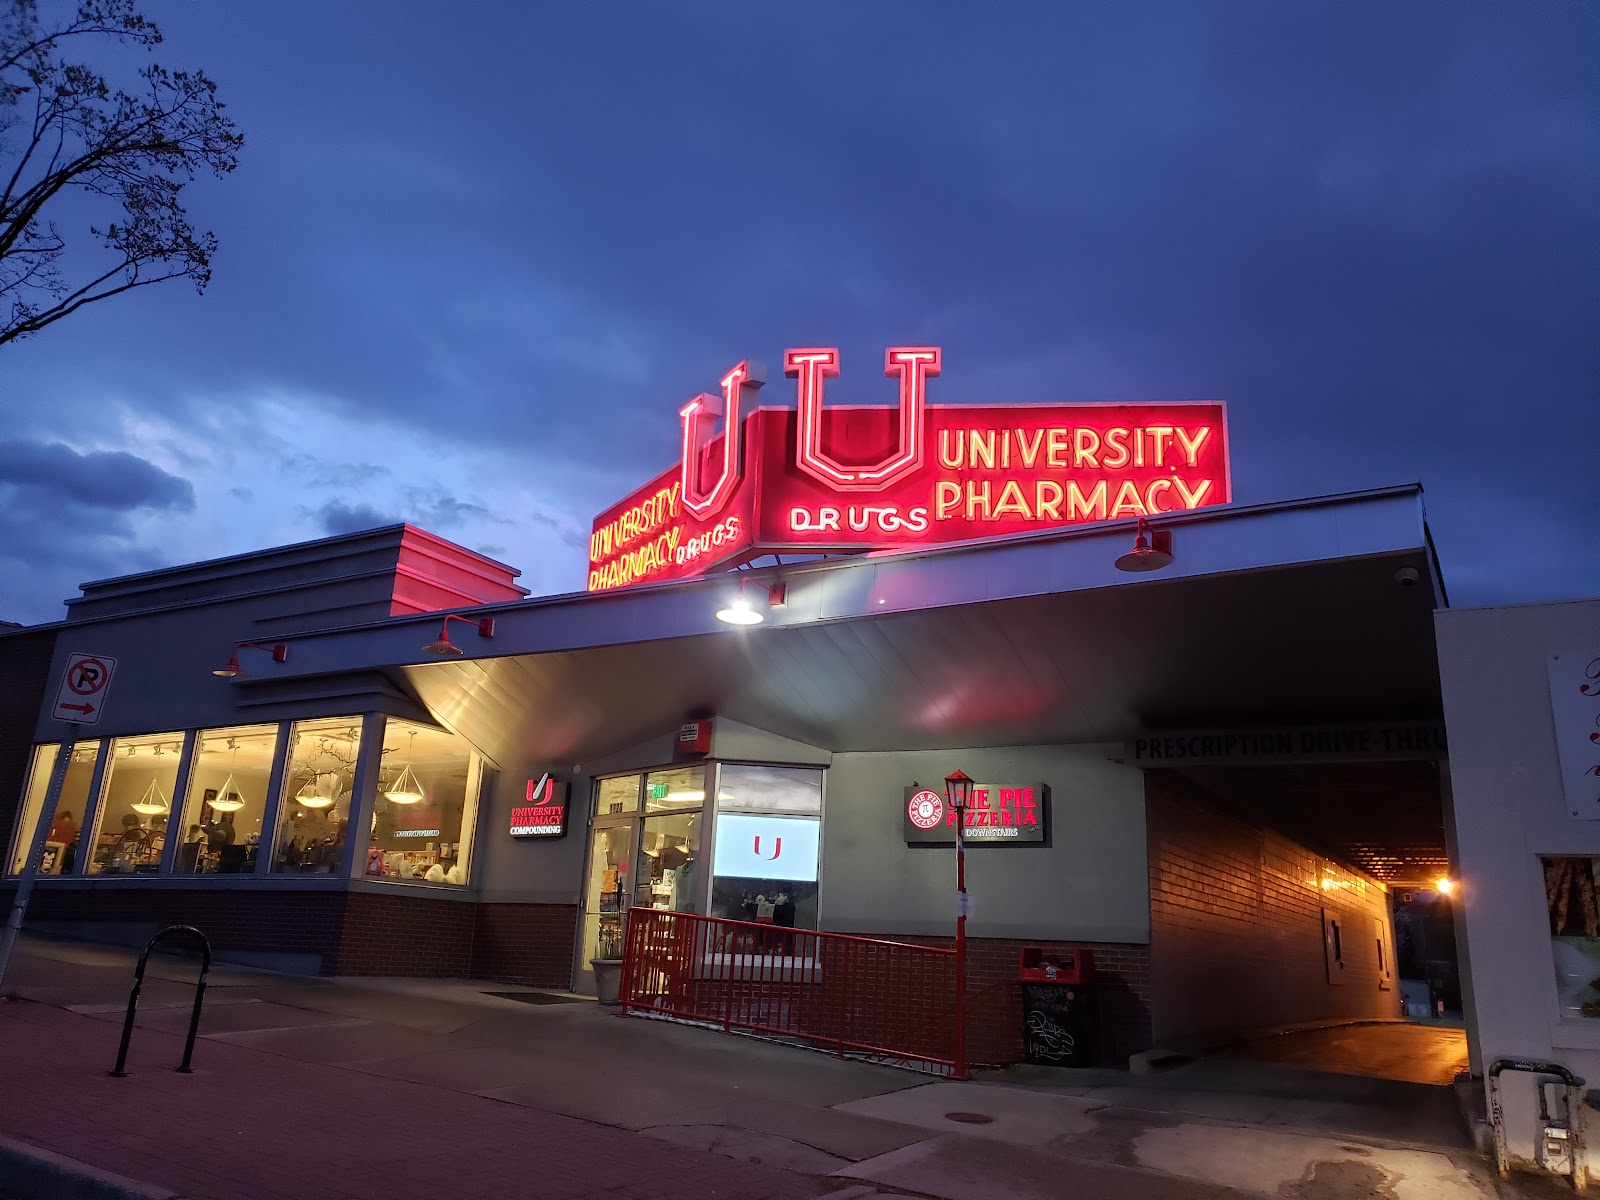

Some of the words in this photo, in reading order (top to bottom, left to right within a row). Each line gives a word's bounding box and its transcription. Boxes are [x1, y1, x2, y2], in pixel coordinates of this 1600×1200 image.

[784, 347, 941, 492] U
[678, 361, 748, 521] U
[937, 425, 1212, 471] UNIVERSITY
[935, 478, 1212, 522] PHARMACY
[590, 482, 681, 563] UNIVERSITY
[790, 506, 929, 533] DRUGS
[676, 517, 741, 566] DRUGS
[588, 525, 684, 592] PHARMACY
[1136, 733, 1291, 759] PRESCRIPTION
[651, 784, 667, 799] EXIT
[912, 794, 926, 809] THE
[927, 794, 940, 806] PIE
[998, 787, 1038, 809] PIE
[510, 815, 563, 826] PHARMACY
[511, 806, 564, 817] UNIVERSITY
[912, 808, 941, 826] PIZZERIA
[946, 810, 1038, 827] PZZERIA
[510, 825, 561, 836] COMPOUNDING
[964, 827, 1019, 838] DOWNSTAIRS
[754, 835, 782, 861] U
